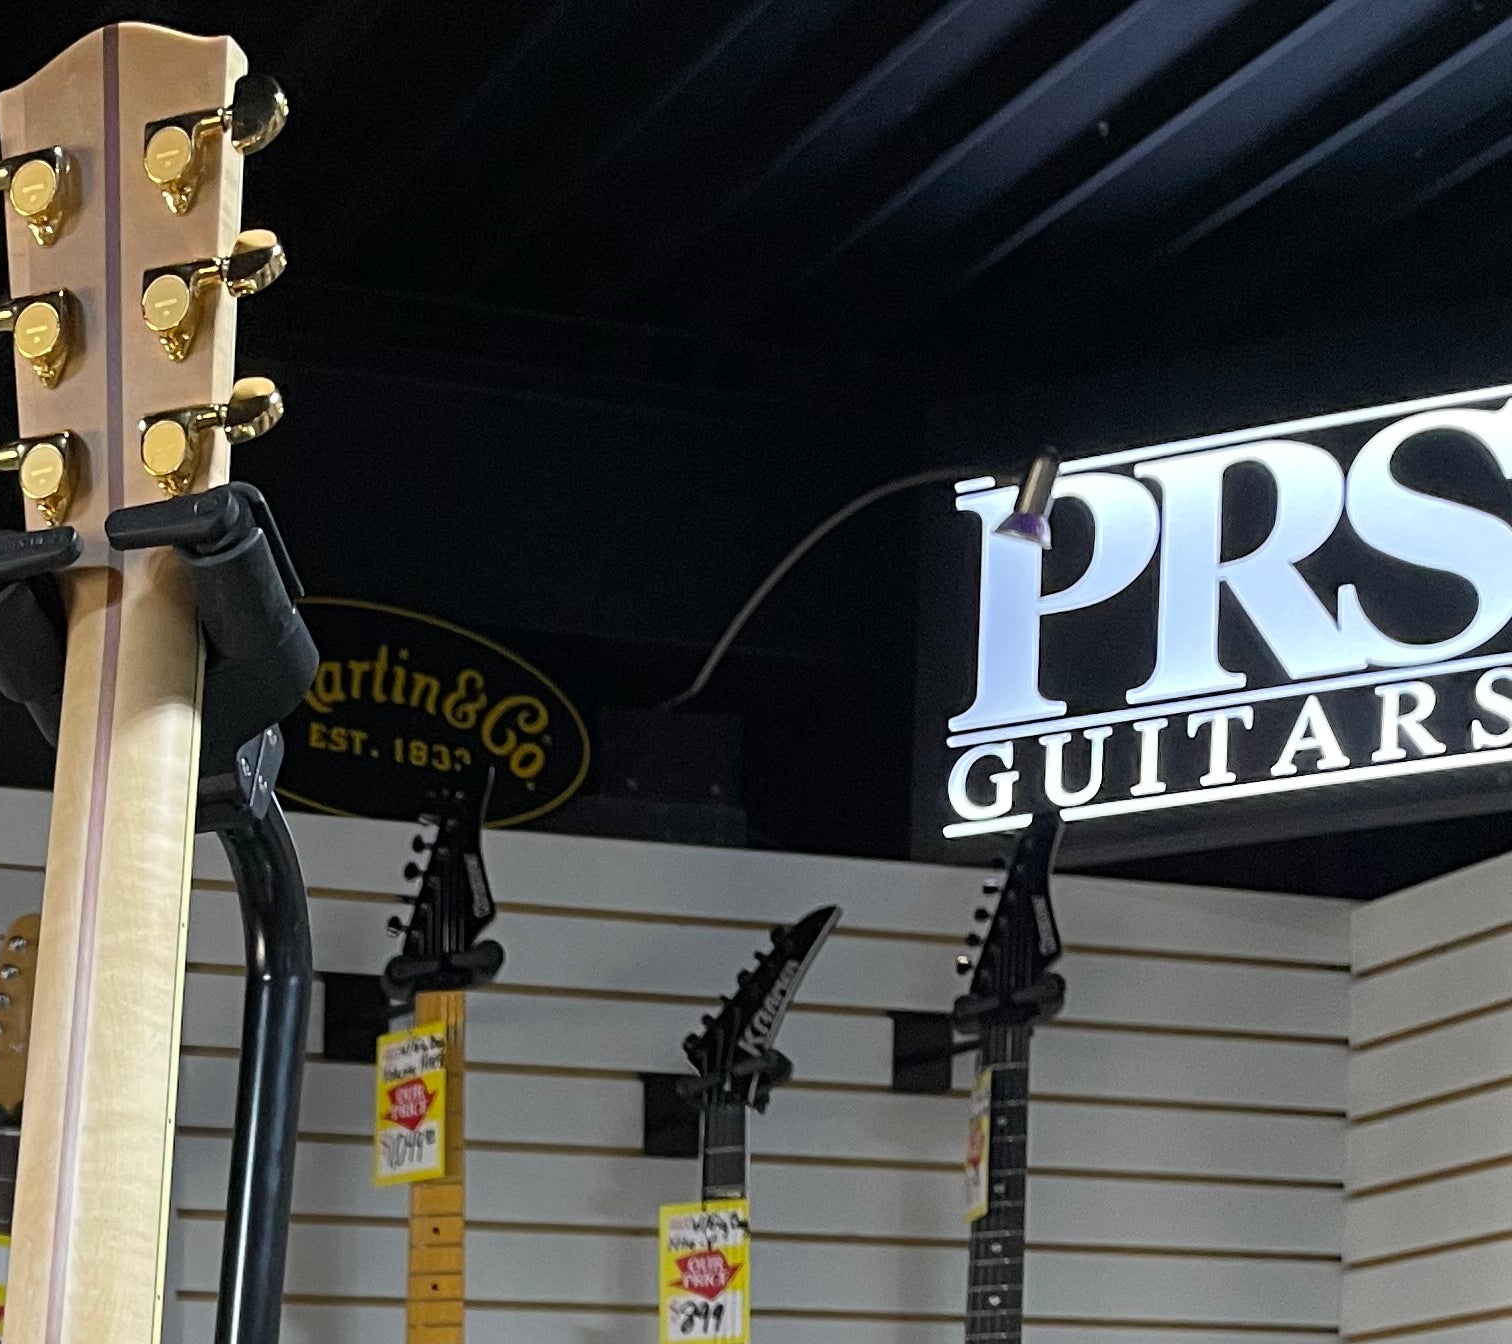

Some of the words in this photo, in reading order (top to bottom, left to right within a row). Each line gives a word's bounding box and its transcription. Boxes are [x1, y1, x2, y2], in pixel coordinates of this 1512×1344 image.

[948, 398, 1512, 733] PRS
[308, 721, 379, 757] EST.
[947, 666, 1512, 822] GUITARS
[686, 1256, 725, 1274] OUR
